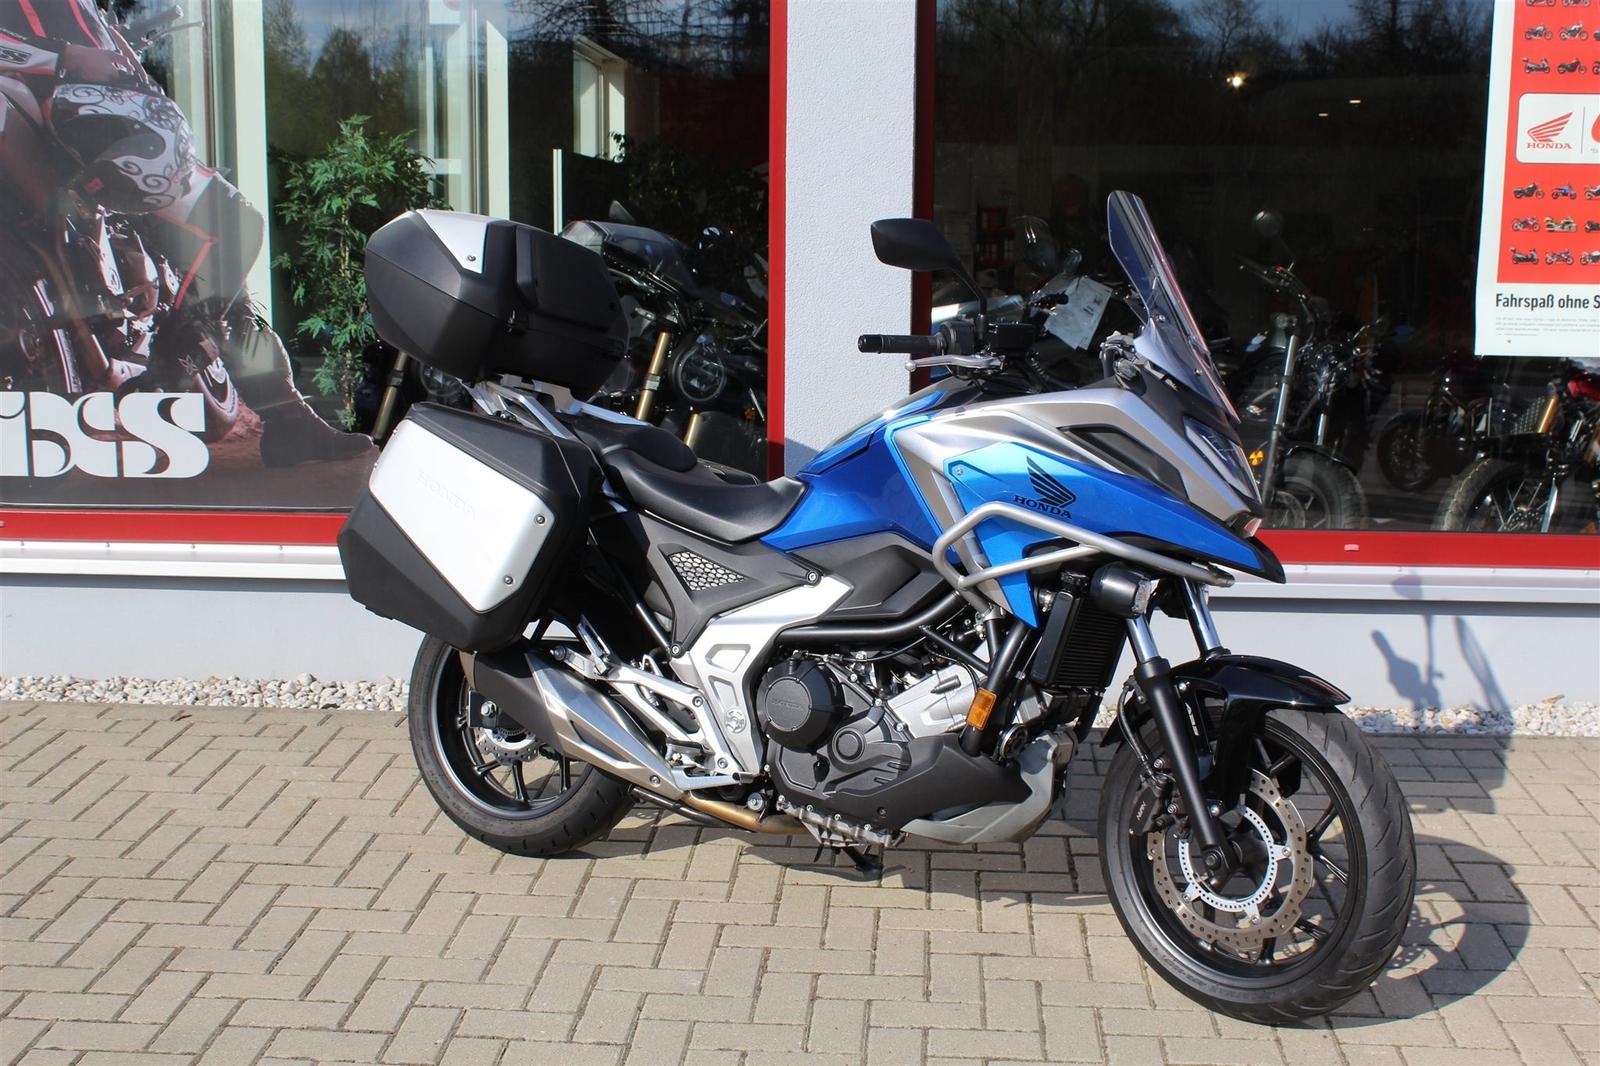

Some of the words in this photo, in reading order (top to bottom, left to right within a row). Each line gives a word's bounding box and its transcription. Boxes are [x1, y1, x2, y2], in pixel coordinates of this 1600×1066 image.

[1527, 142, 1572, 150] HONDA
[1496, 293, 1554, 312] Fahrspaß
[1558, 294, 1590, 309] ohne
[1013, 494, 1072, 519] HONDA
